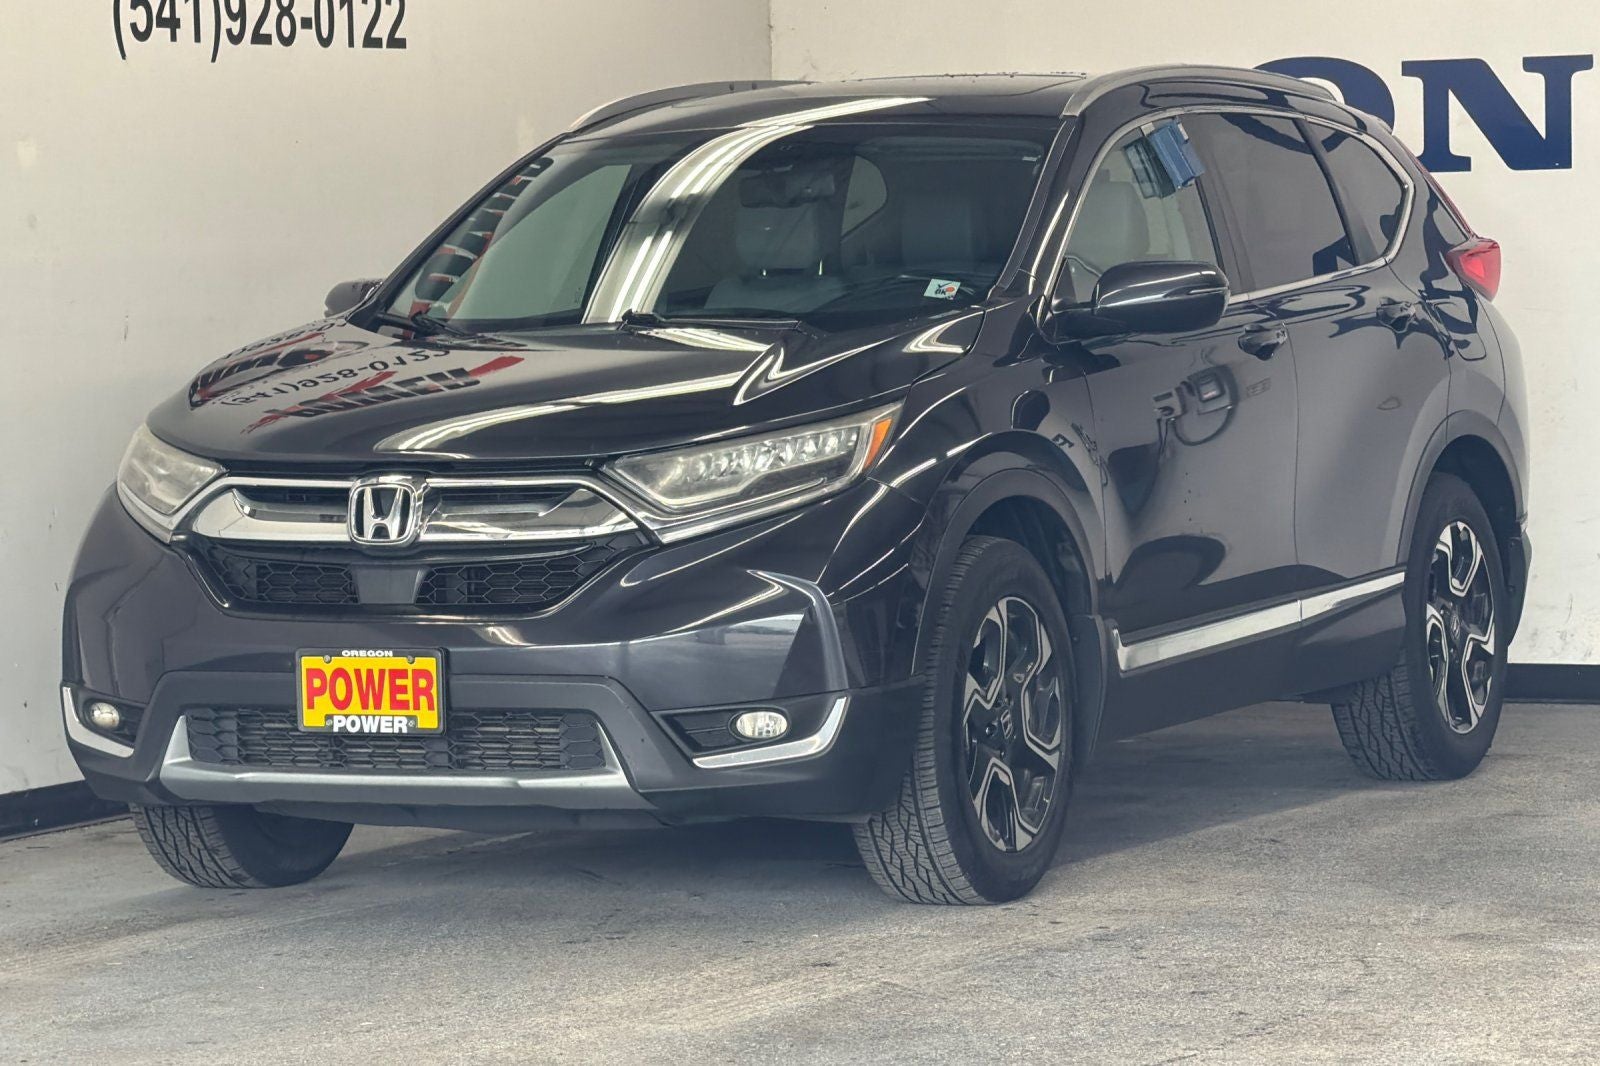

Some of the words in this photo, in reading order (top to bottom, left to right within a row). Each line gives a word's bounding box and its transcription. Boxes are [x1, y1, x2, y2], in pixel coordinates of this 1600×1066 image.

[113, 0, 407, 63] (541)928-0122
[341, 650, 394, 658] OREGON
[305, 667, 436, 712] POWER
[332, 715, 408, 734] POWER
